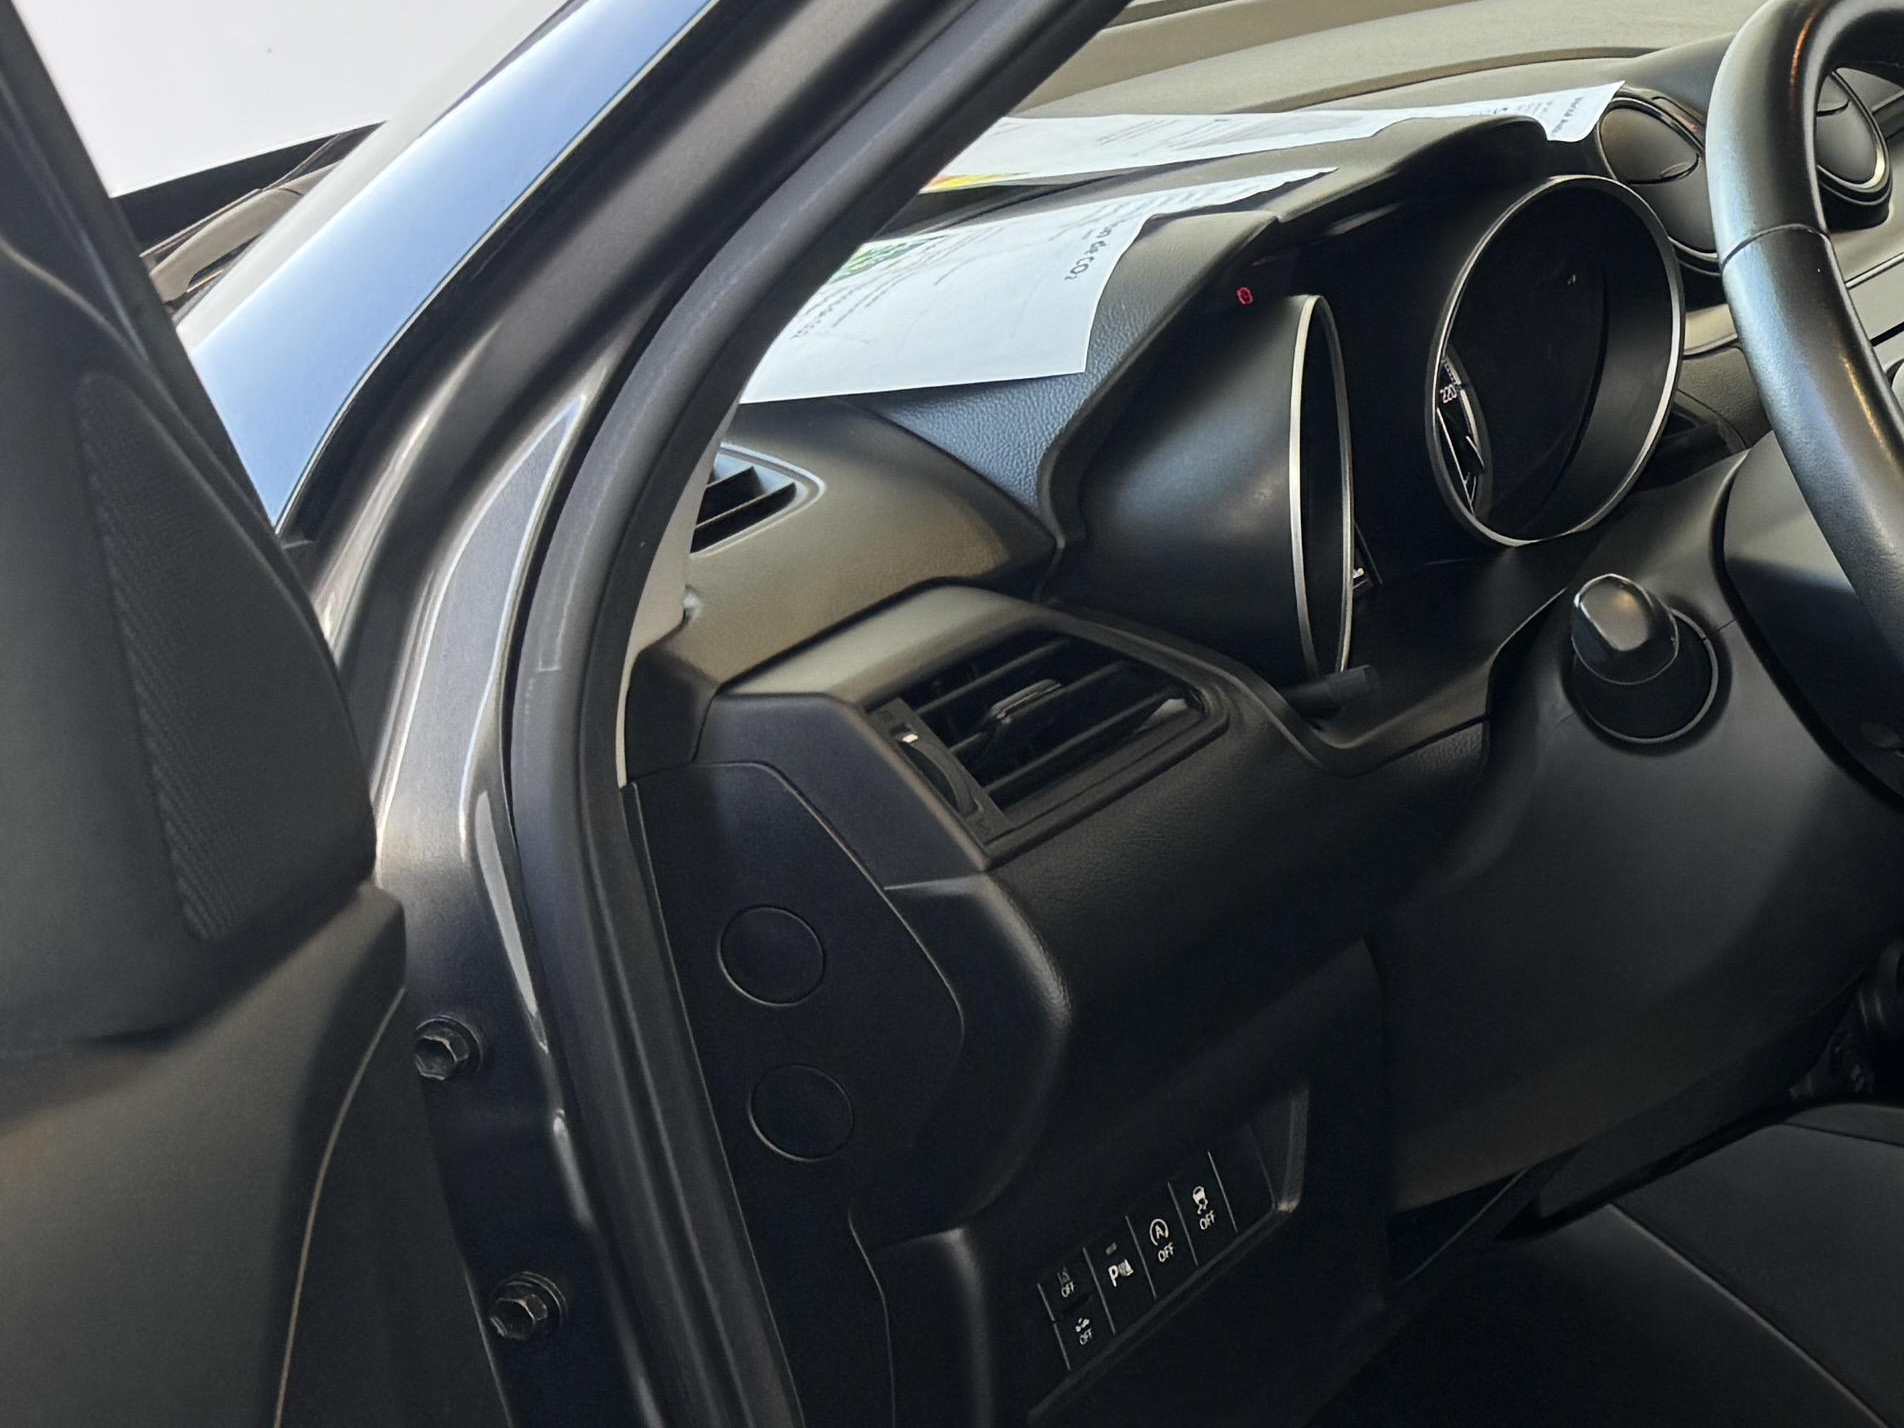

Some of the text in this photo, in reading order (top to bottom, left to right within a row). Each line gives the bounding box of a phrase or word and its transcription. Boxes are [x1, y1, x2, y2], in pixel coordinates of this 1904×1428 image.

[1439, 384, 1458, 404] 220
[1200, 1209, 1215, 1231] OFF
[1157, 1242, 1174, 1263] OFF
[1061, 1281, 1075, 1298] OFF
[1080, 1327, 1093, 1346] OFF
